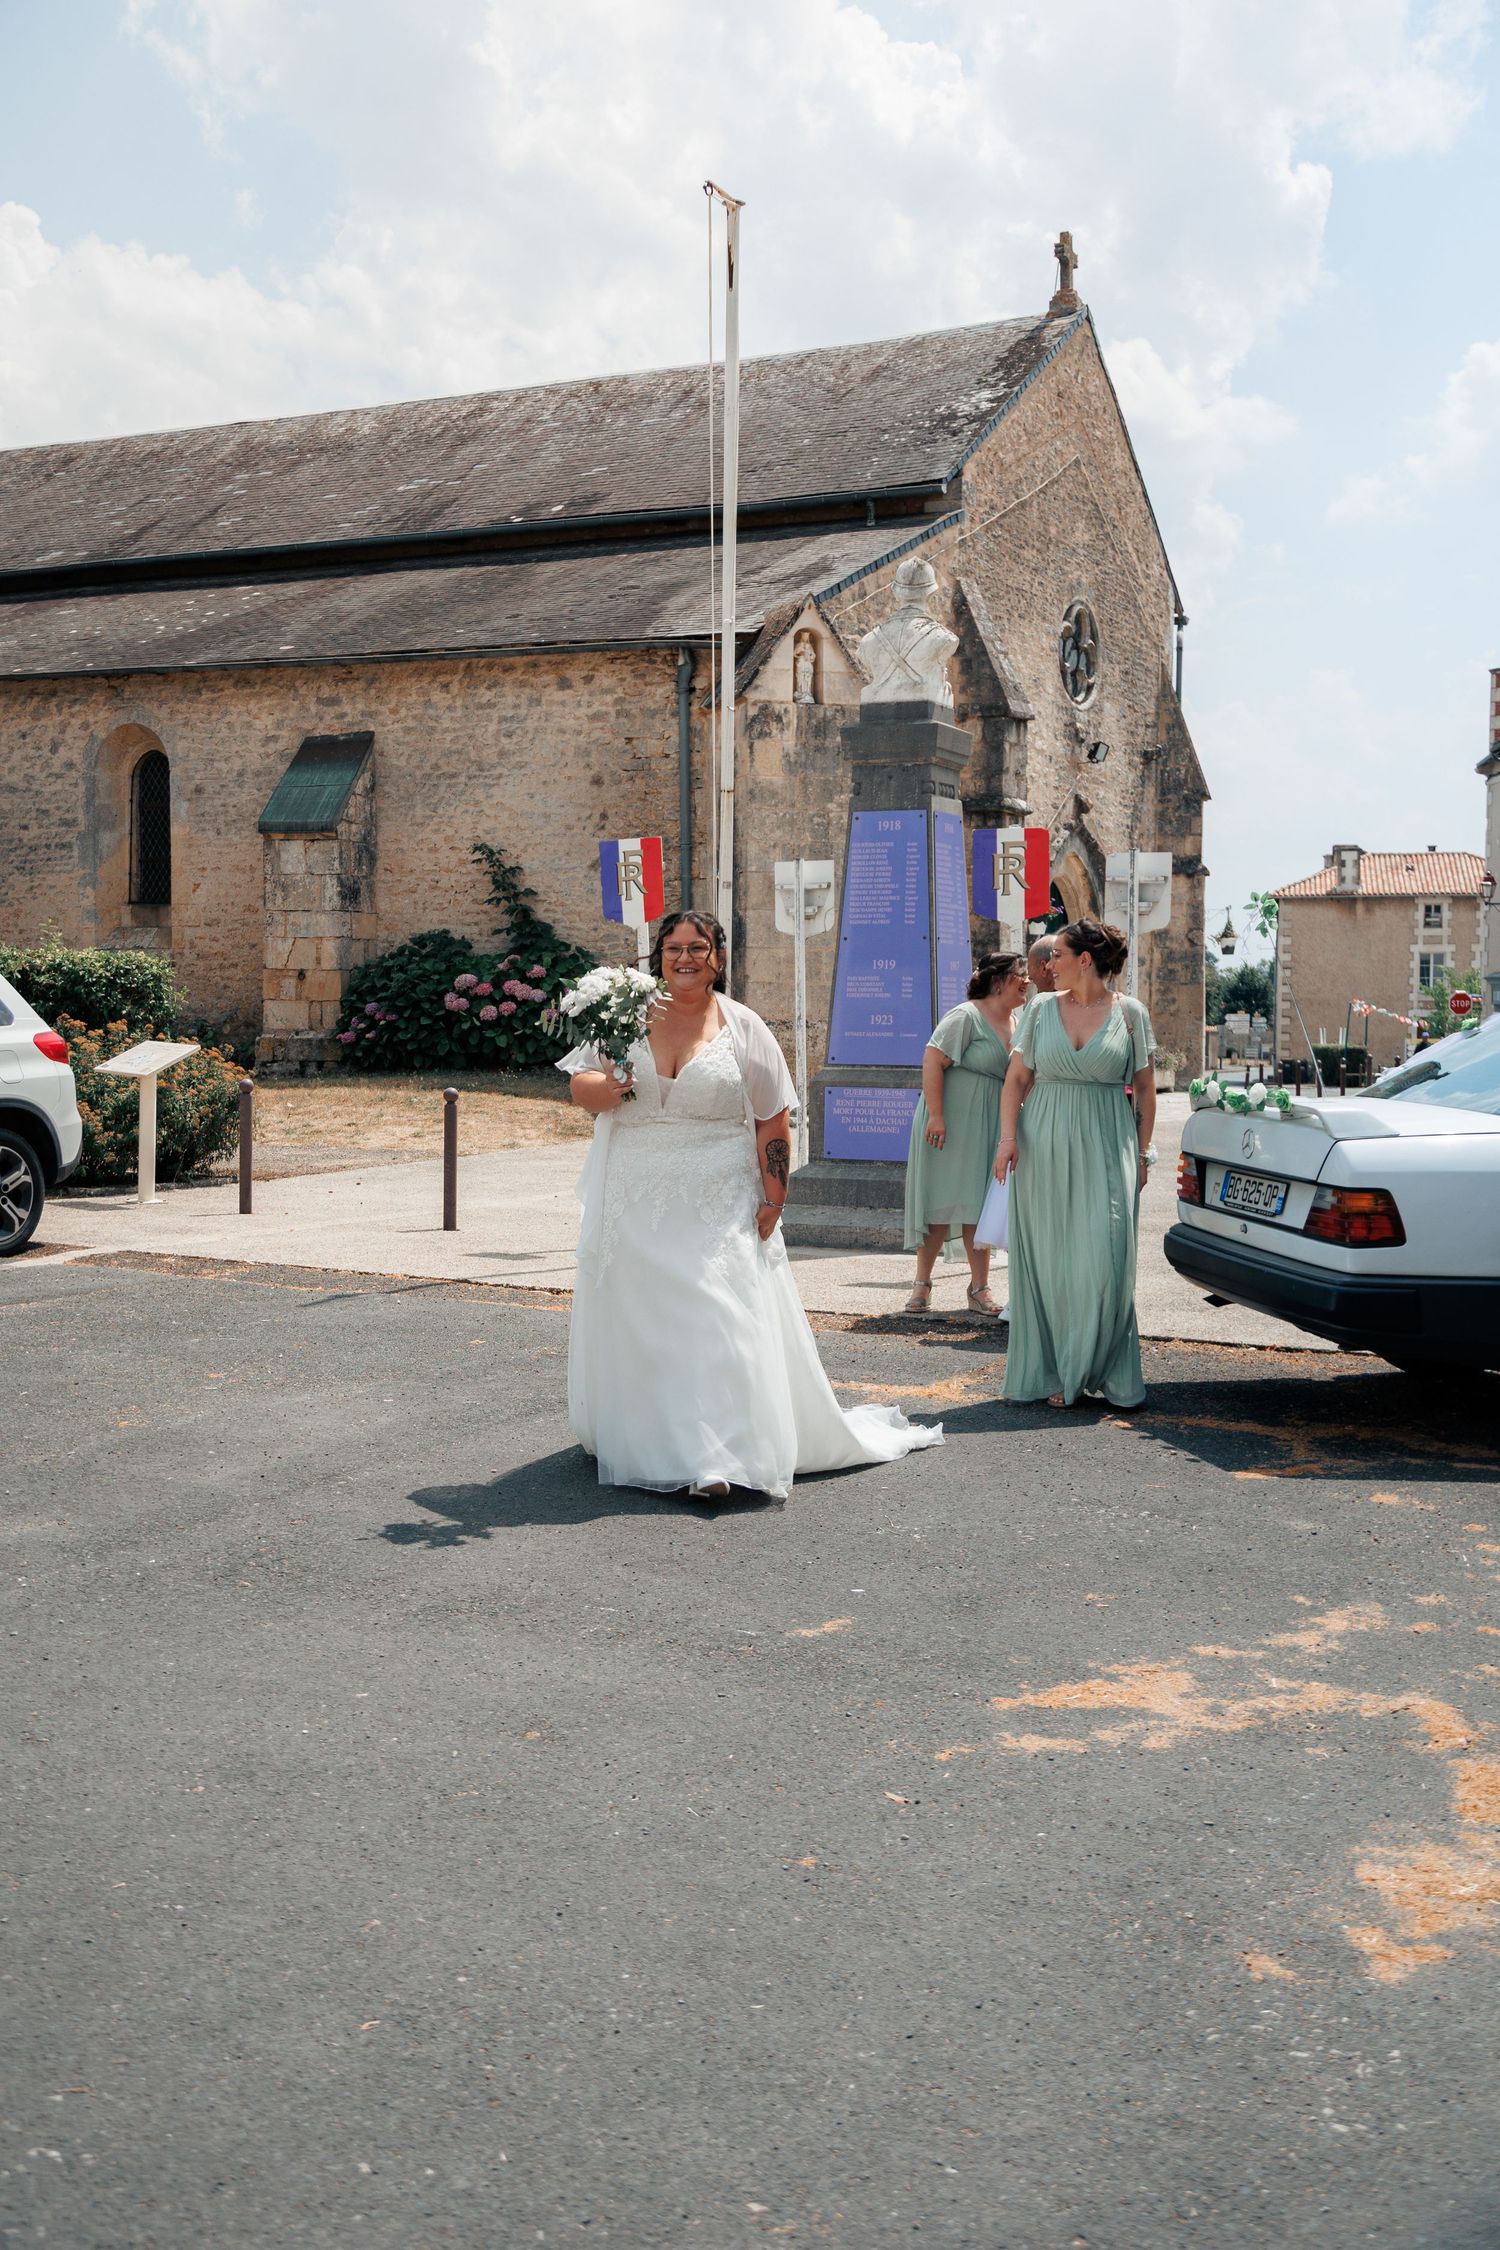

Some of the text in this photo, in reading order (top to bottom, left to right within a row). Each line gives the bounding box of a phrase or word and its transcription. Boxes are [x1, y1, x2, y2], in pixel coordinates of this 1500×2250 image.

[878, 820, 902, 831] 1918
[873, 960, 896, 970] 1919
[1451, 1000, 1470, 1008] STOP
[870, 1015, 893, 1025] 1923
[836, 1099, 913, 1109] RENÉ PIERRE ROUGER
[833, 1107, 854, 1115] MORT
[876, 1108, 886, 1116] LA
[876, 1118, 908, 1126] DACHAU
